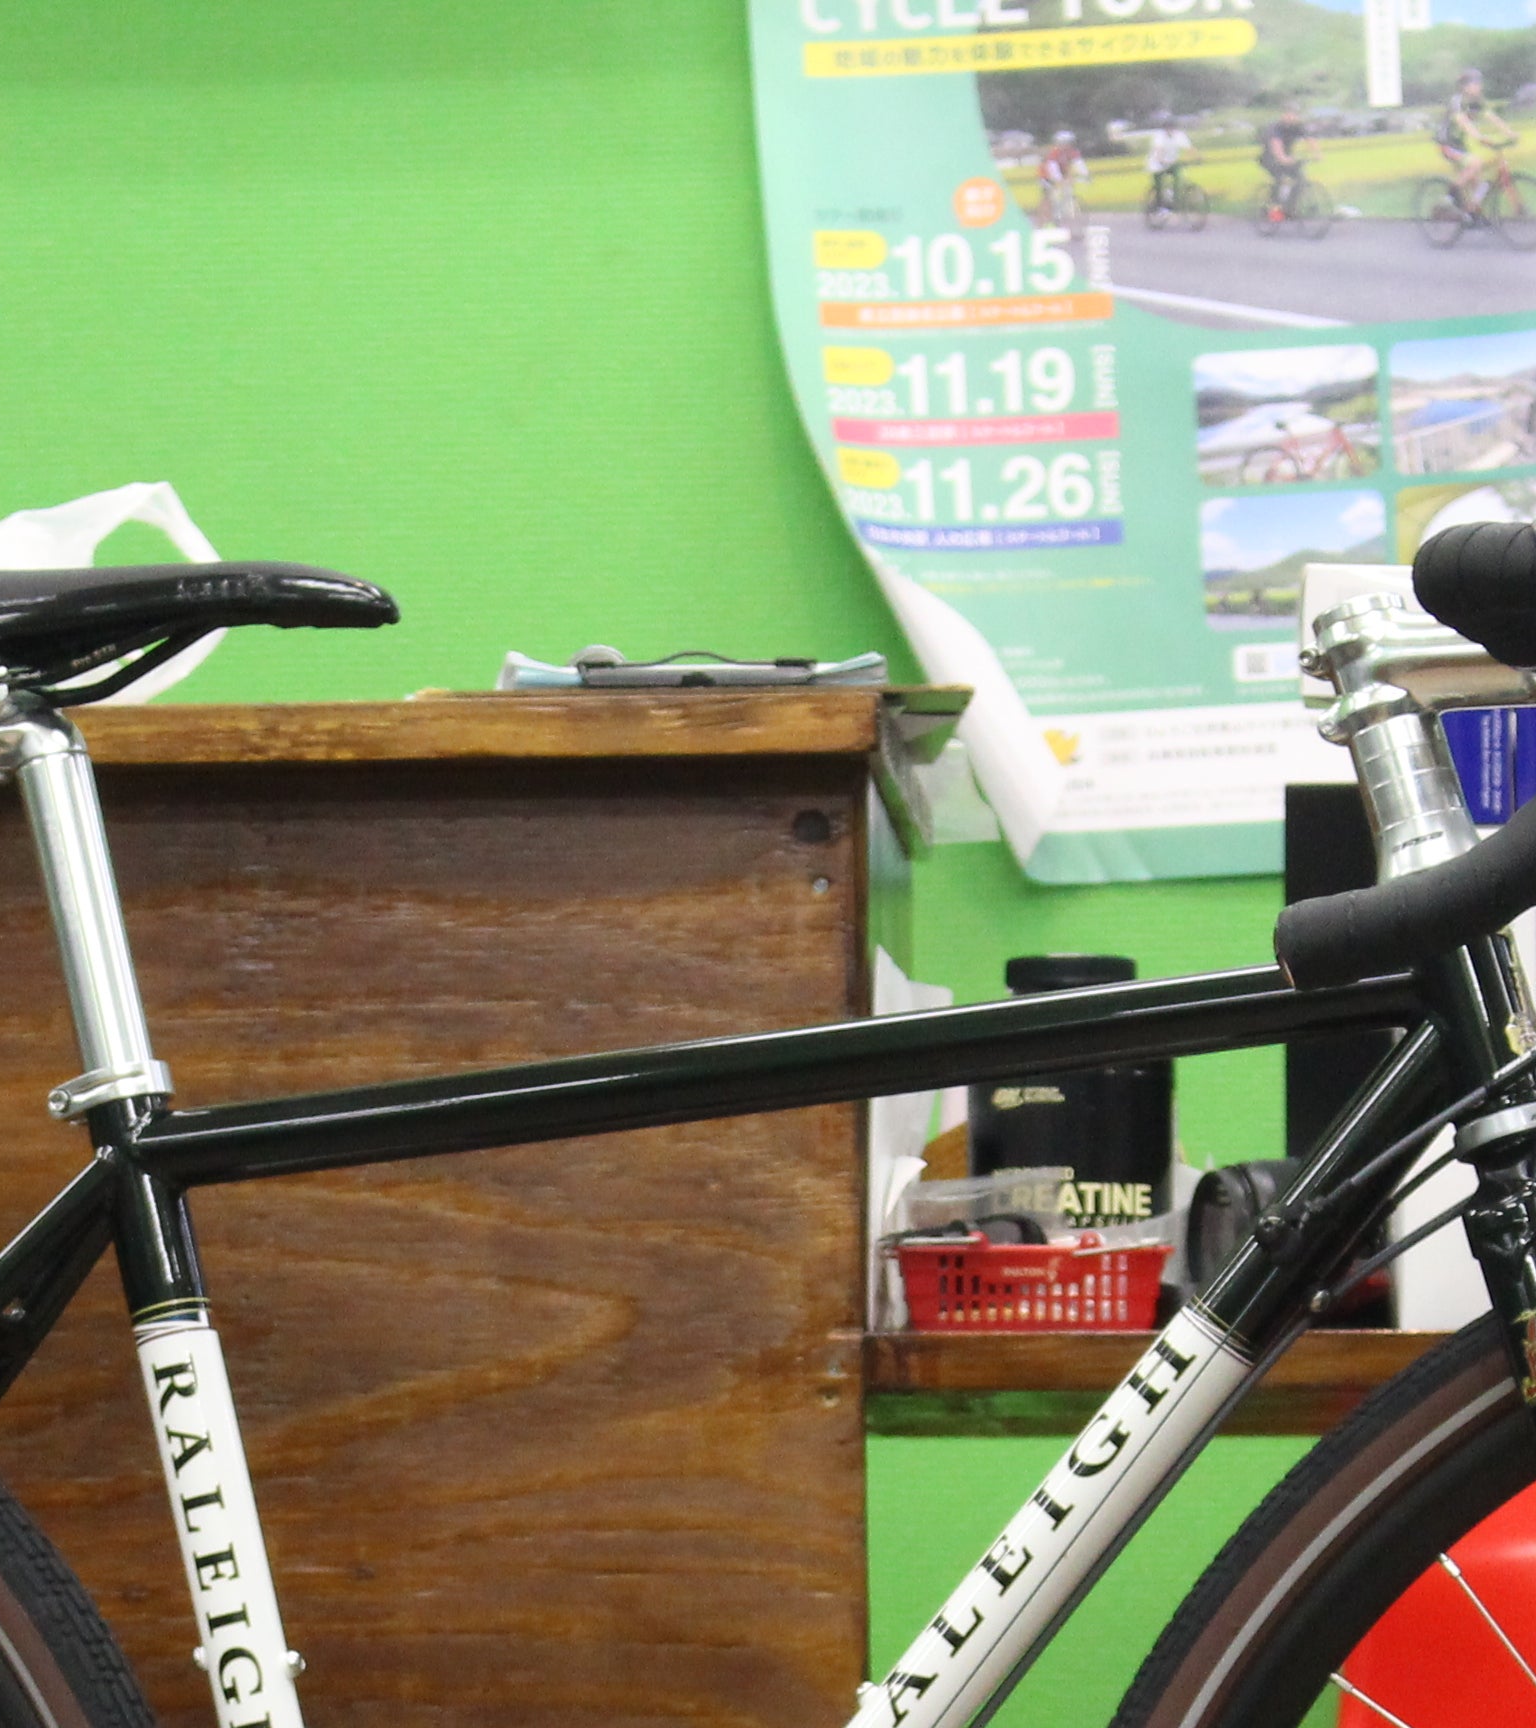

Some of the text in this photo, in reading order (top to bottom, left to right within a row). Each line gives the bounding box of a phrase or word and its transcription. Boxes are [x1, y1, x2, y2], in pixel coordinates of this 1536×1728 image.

[891, 228, 1076, 297] 10.15
[896, 347, 1076, 416] 11.19
[904, 453, 1095, 521] 11.26
[996, 1181, 1152, 1216] CREATINE
